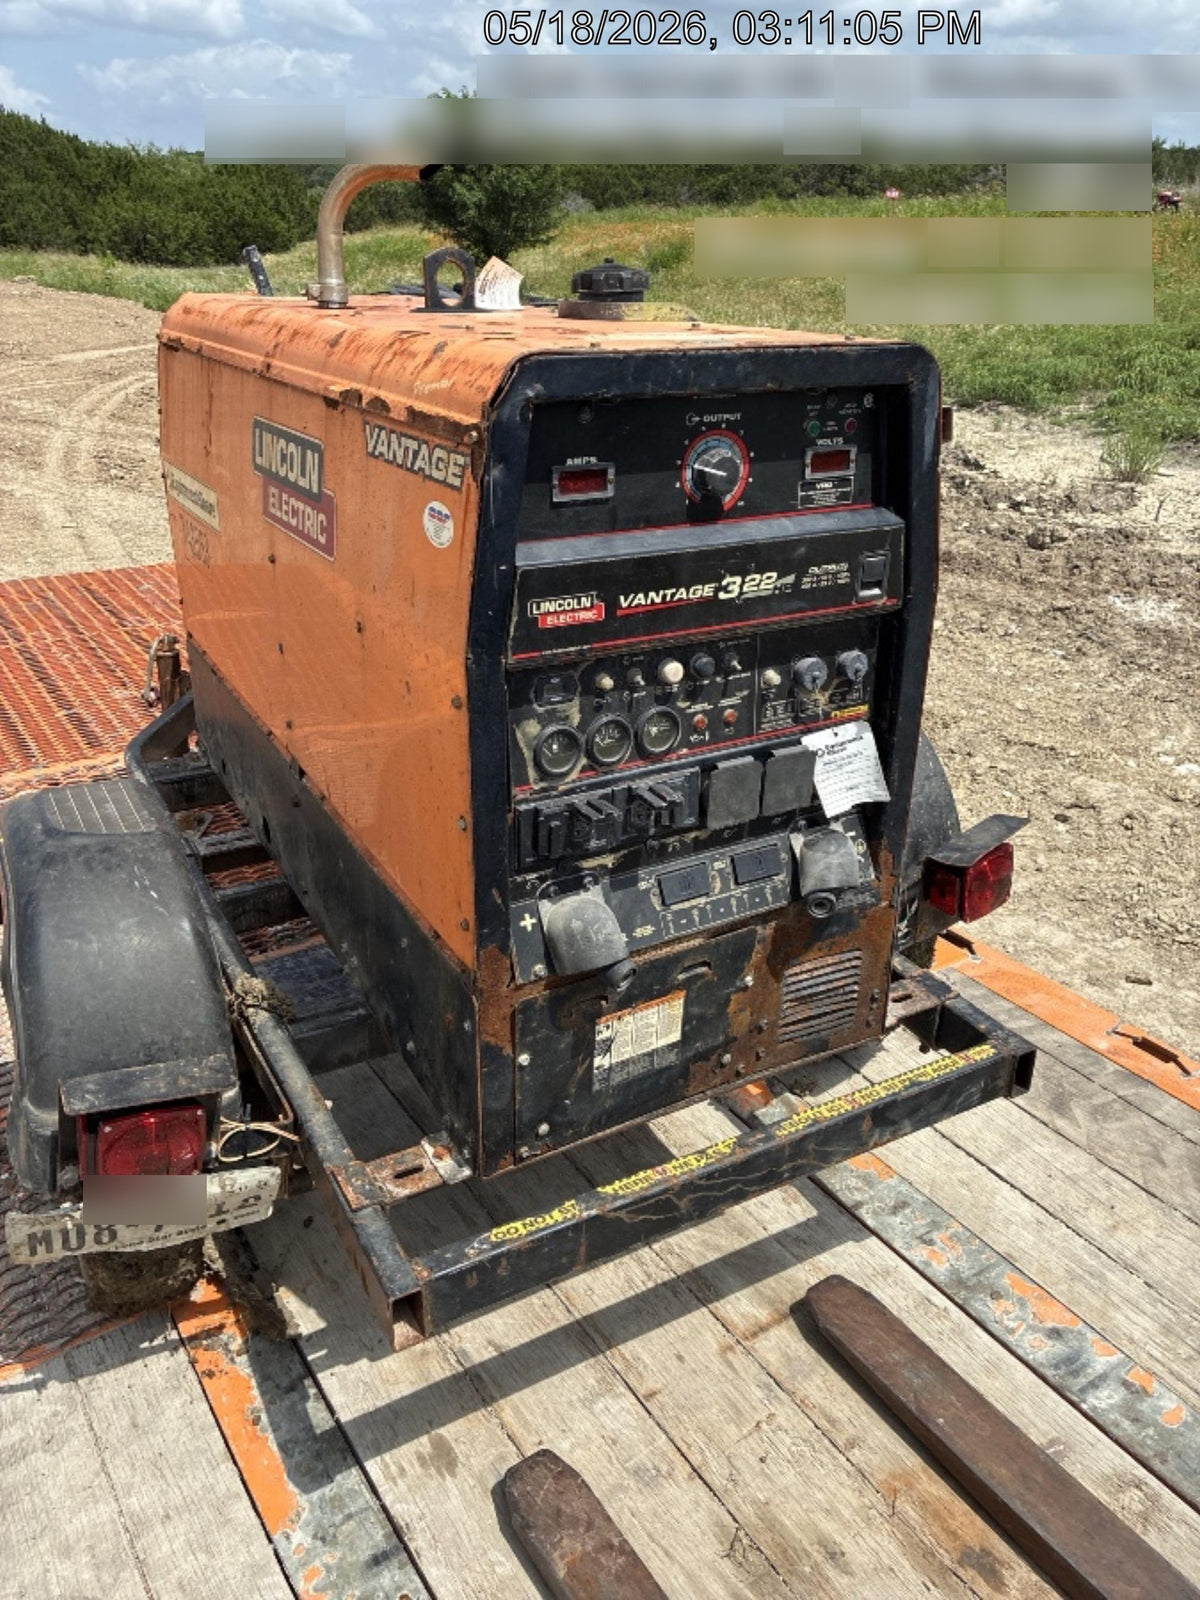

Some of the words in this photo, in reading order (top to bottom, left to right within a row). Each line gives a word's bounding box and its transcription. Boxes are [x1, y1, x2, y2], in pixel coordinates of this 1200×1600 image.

[703, 413, 742, 422] OUTPUT
[816, 437, 844, 446] VOLTS
[254, 427, 320, 494] LINCOLN
[365, 424, 465, 488] VANTAGE
[566, 456, 598, 466] AMPS
[269, 485, 327, 545] ELECTRIC
[619, 584, 716, 609] VANTAGE
[532, 597, 592, 615] LINCOLN
[547, 609, 599, 625] ELECTRIC
[494, 1227, 519, 1240] DO
